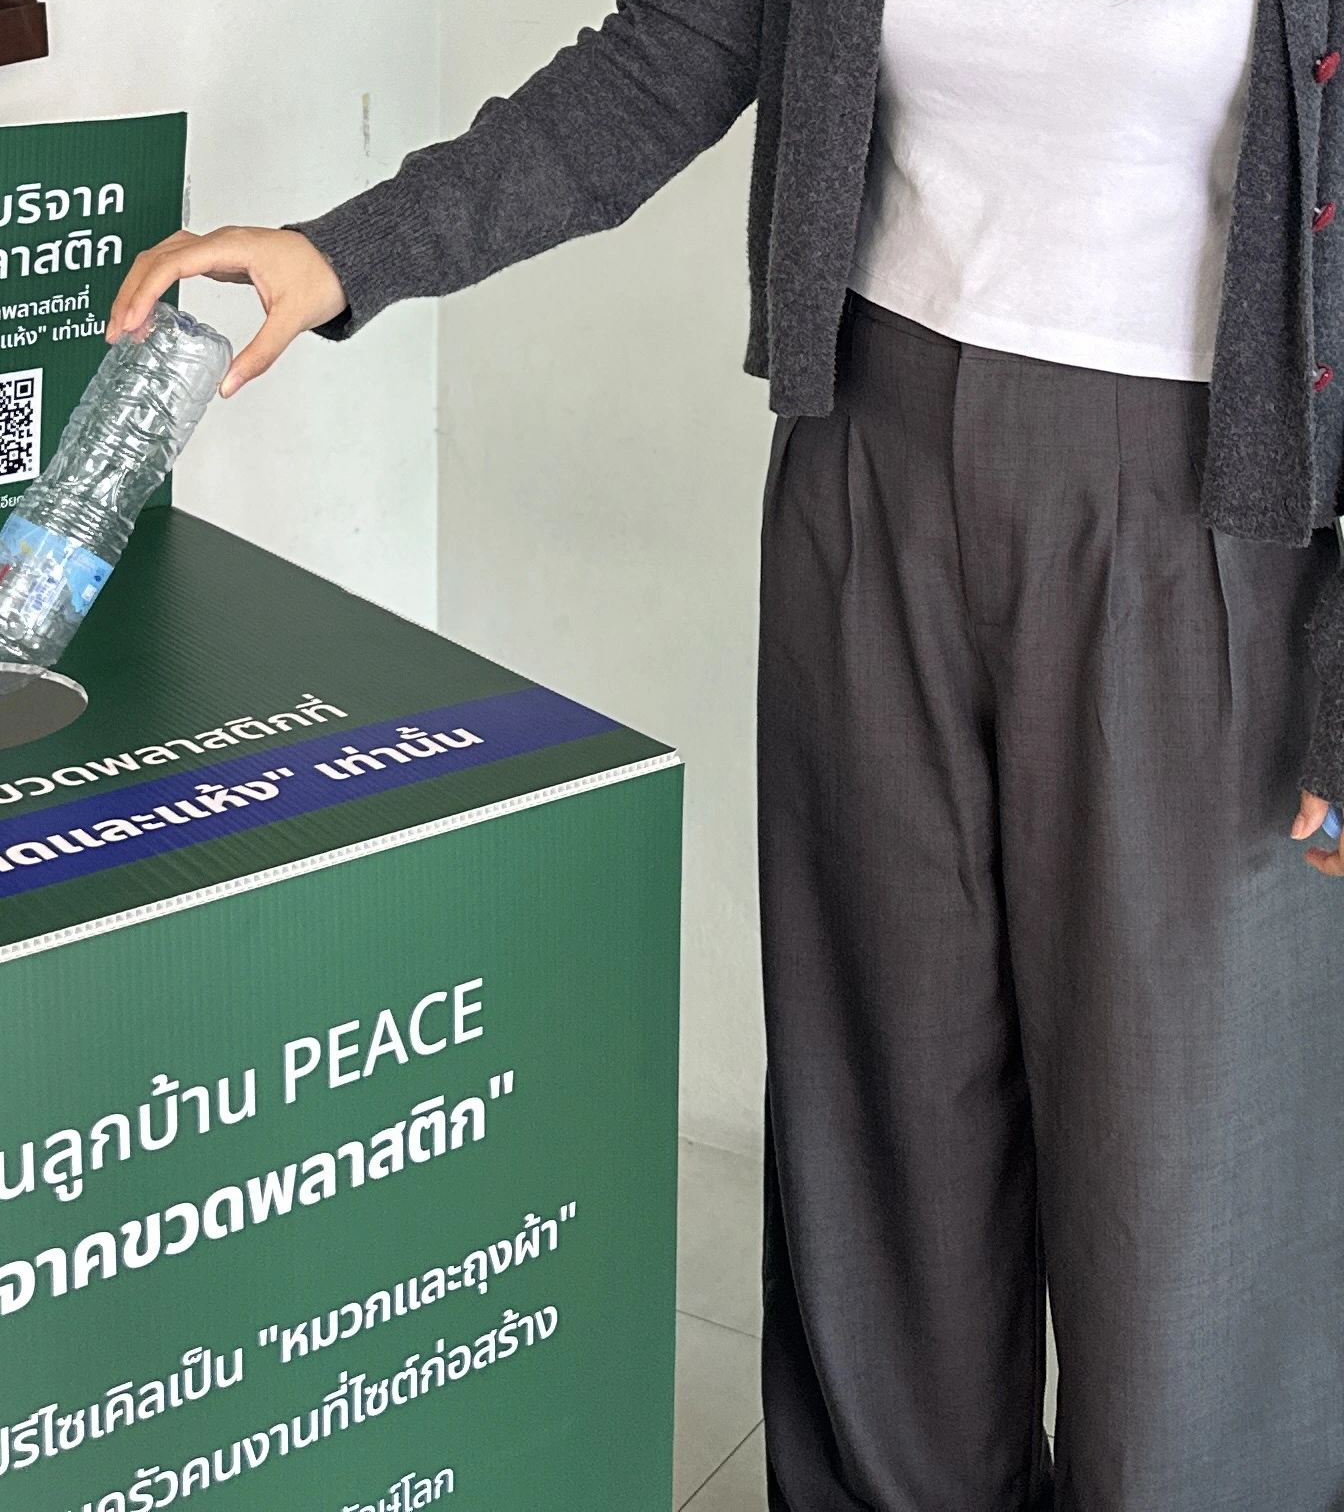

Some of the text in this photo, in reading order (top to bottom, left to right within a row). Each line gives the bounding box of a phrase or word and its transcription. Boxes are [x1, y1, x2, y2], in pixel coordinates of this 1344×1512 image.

[53, 313, 105, 341] เท่านั้น
[314, 721, 485, 780] เท่านั้น
[285, 978, 483, 1103] PEACE
[260, 1203, 575, 1362] "หมวกและถุงผ้า"
